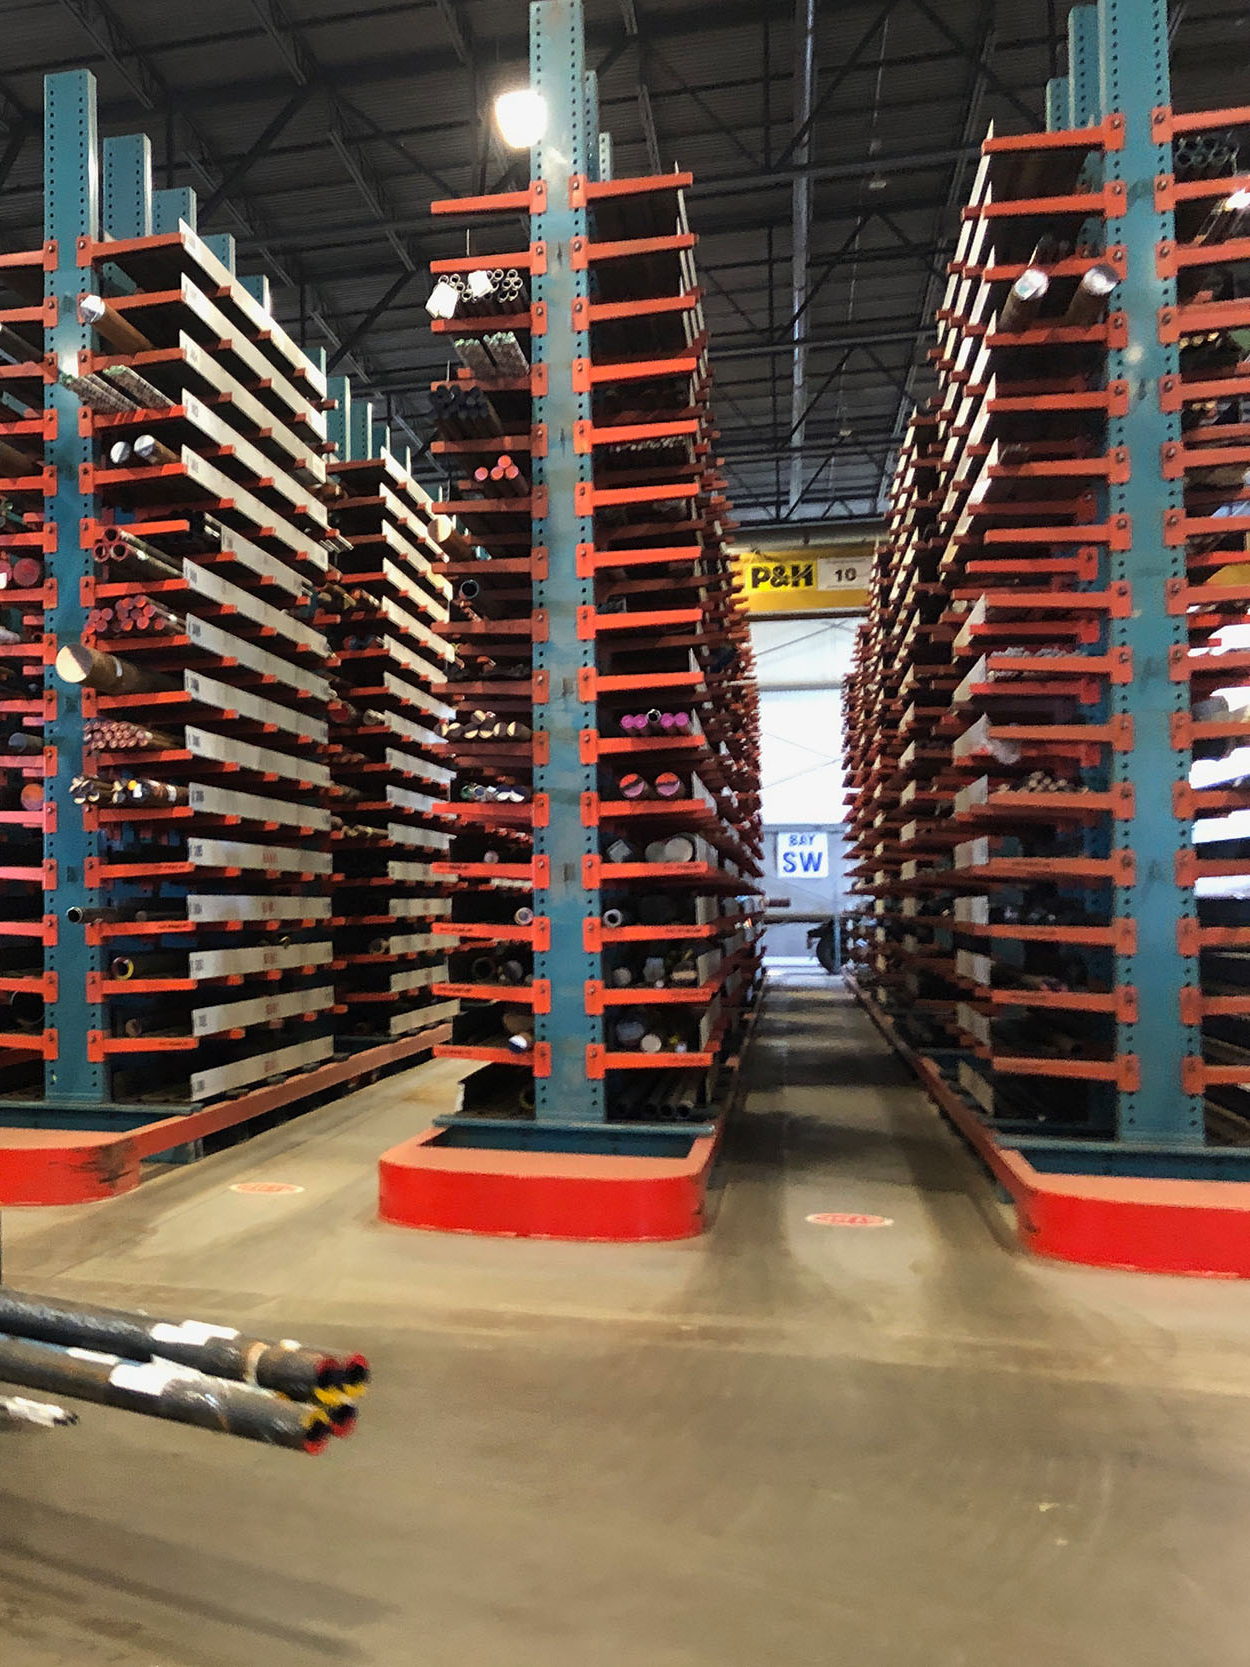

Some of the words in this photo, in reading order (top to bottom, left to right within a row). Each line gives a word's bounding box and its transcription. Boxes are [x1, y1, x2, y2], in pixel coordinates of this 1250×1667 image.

[751, 564, 814, 588] P&H
[835, 567, 857, 582] 10
[790, 834, 816, 846] BAY
[783, 851, 823, 873] SW
